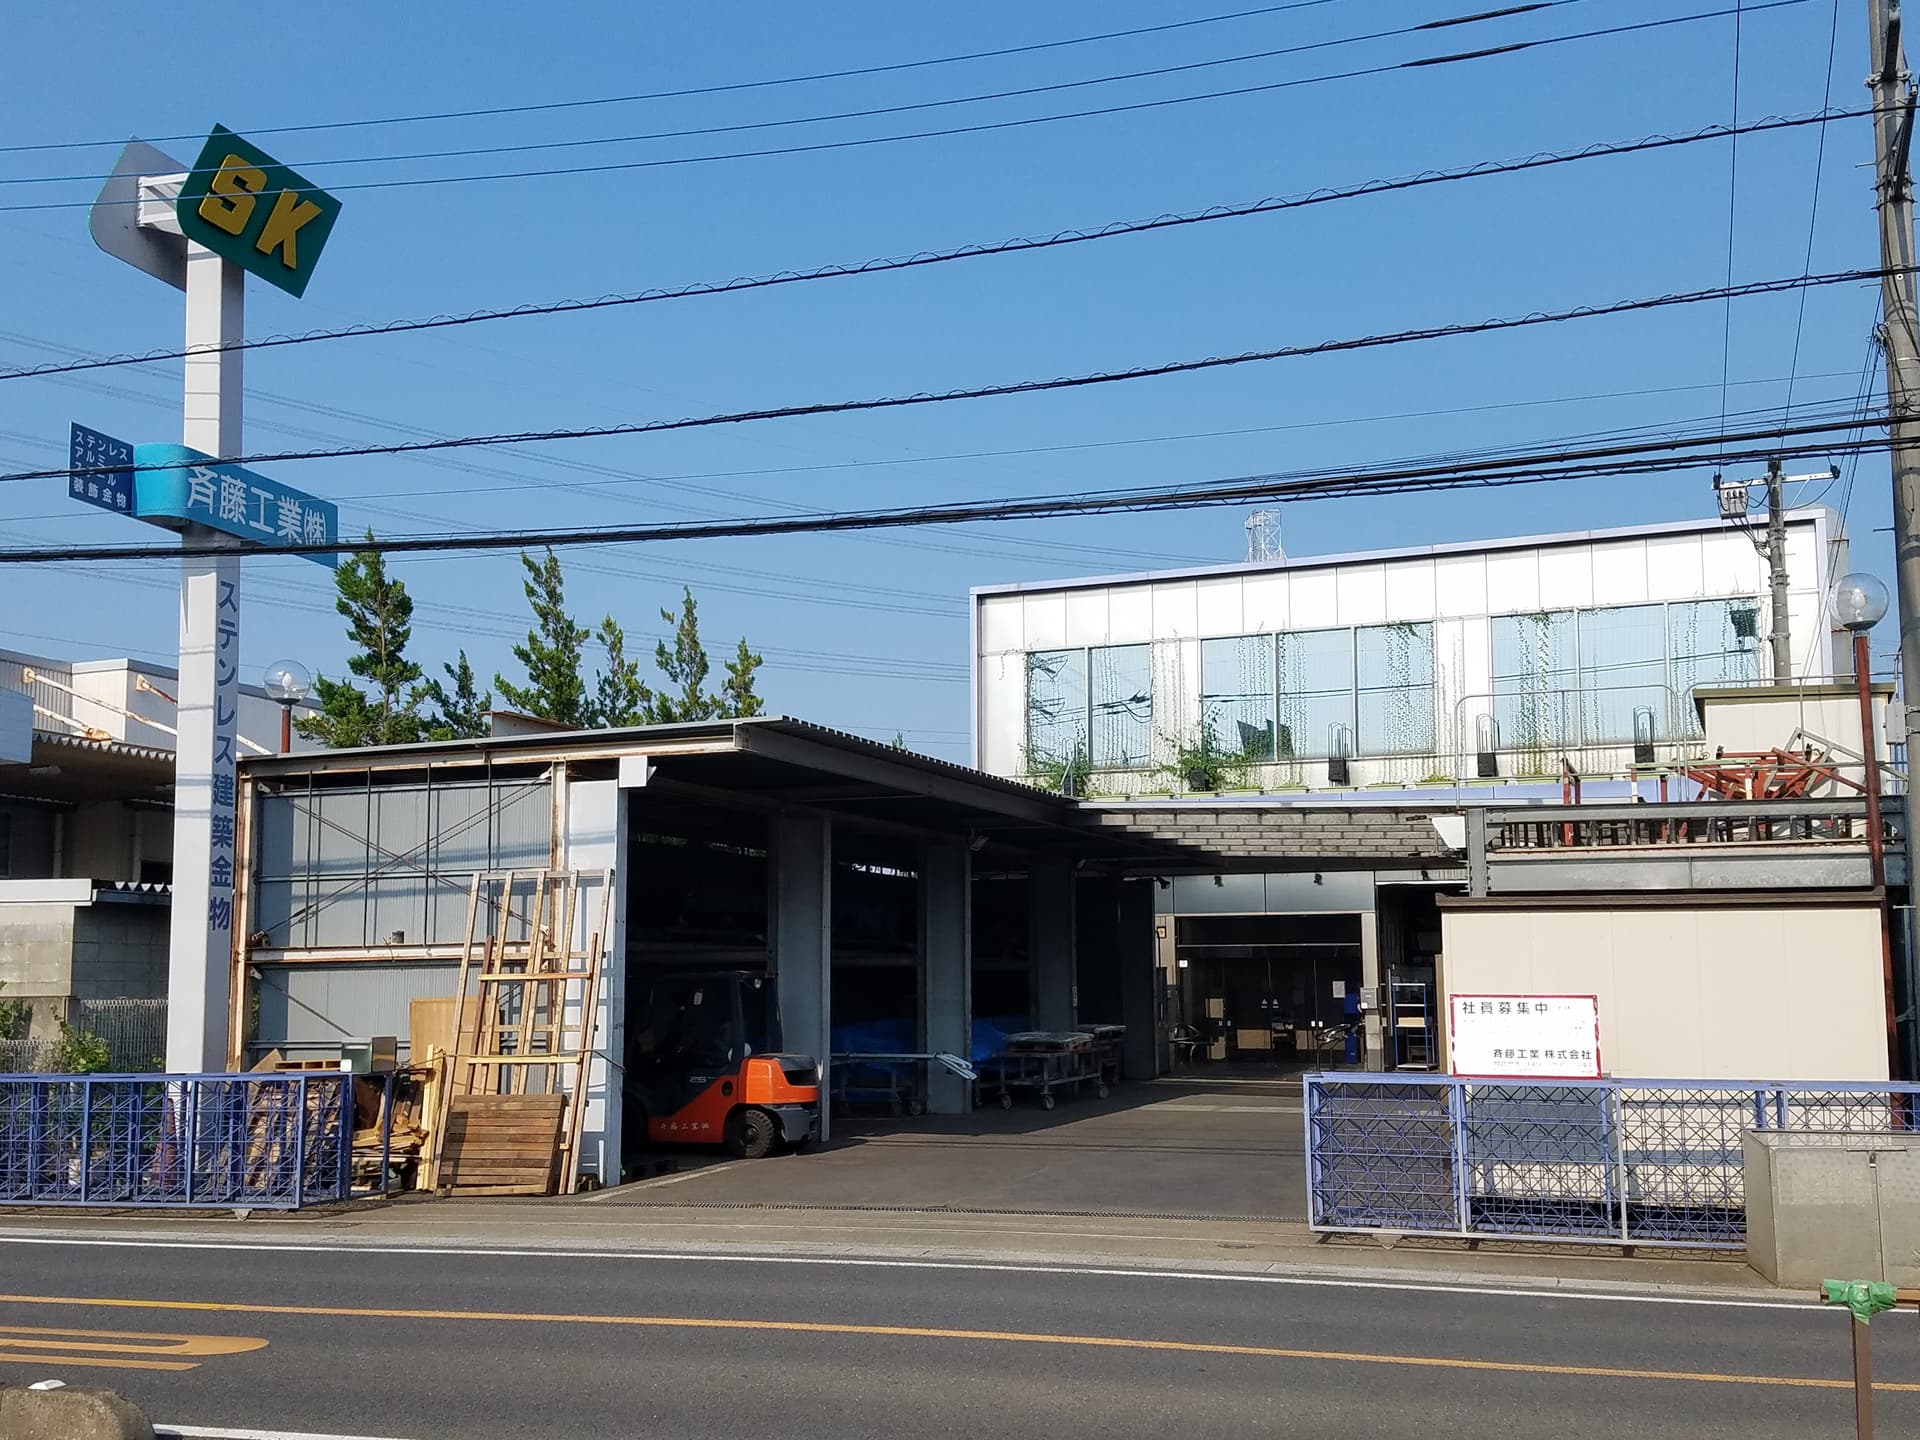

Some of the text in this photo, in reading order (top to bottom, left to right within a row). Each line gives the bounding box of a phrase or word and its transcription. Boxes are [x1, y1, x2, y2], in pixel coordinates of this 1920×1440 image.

[198, 153, 323, 270] SK
[74, 446, 106, 468] アルミ
[75, 431, 128, 462] ステンレス
[73, 477, 127, 509] 装飾金物
[208, 579, 238, 932] ステンレス建築金物
[1461, 1001, 1549, 1015] 社員募集中
[1545, 1049, 1592, 1060] 株式会社
